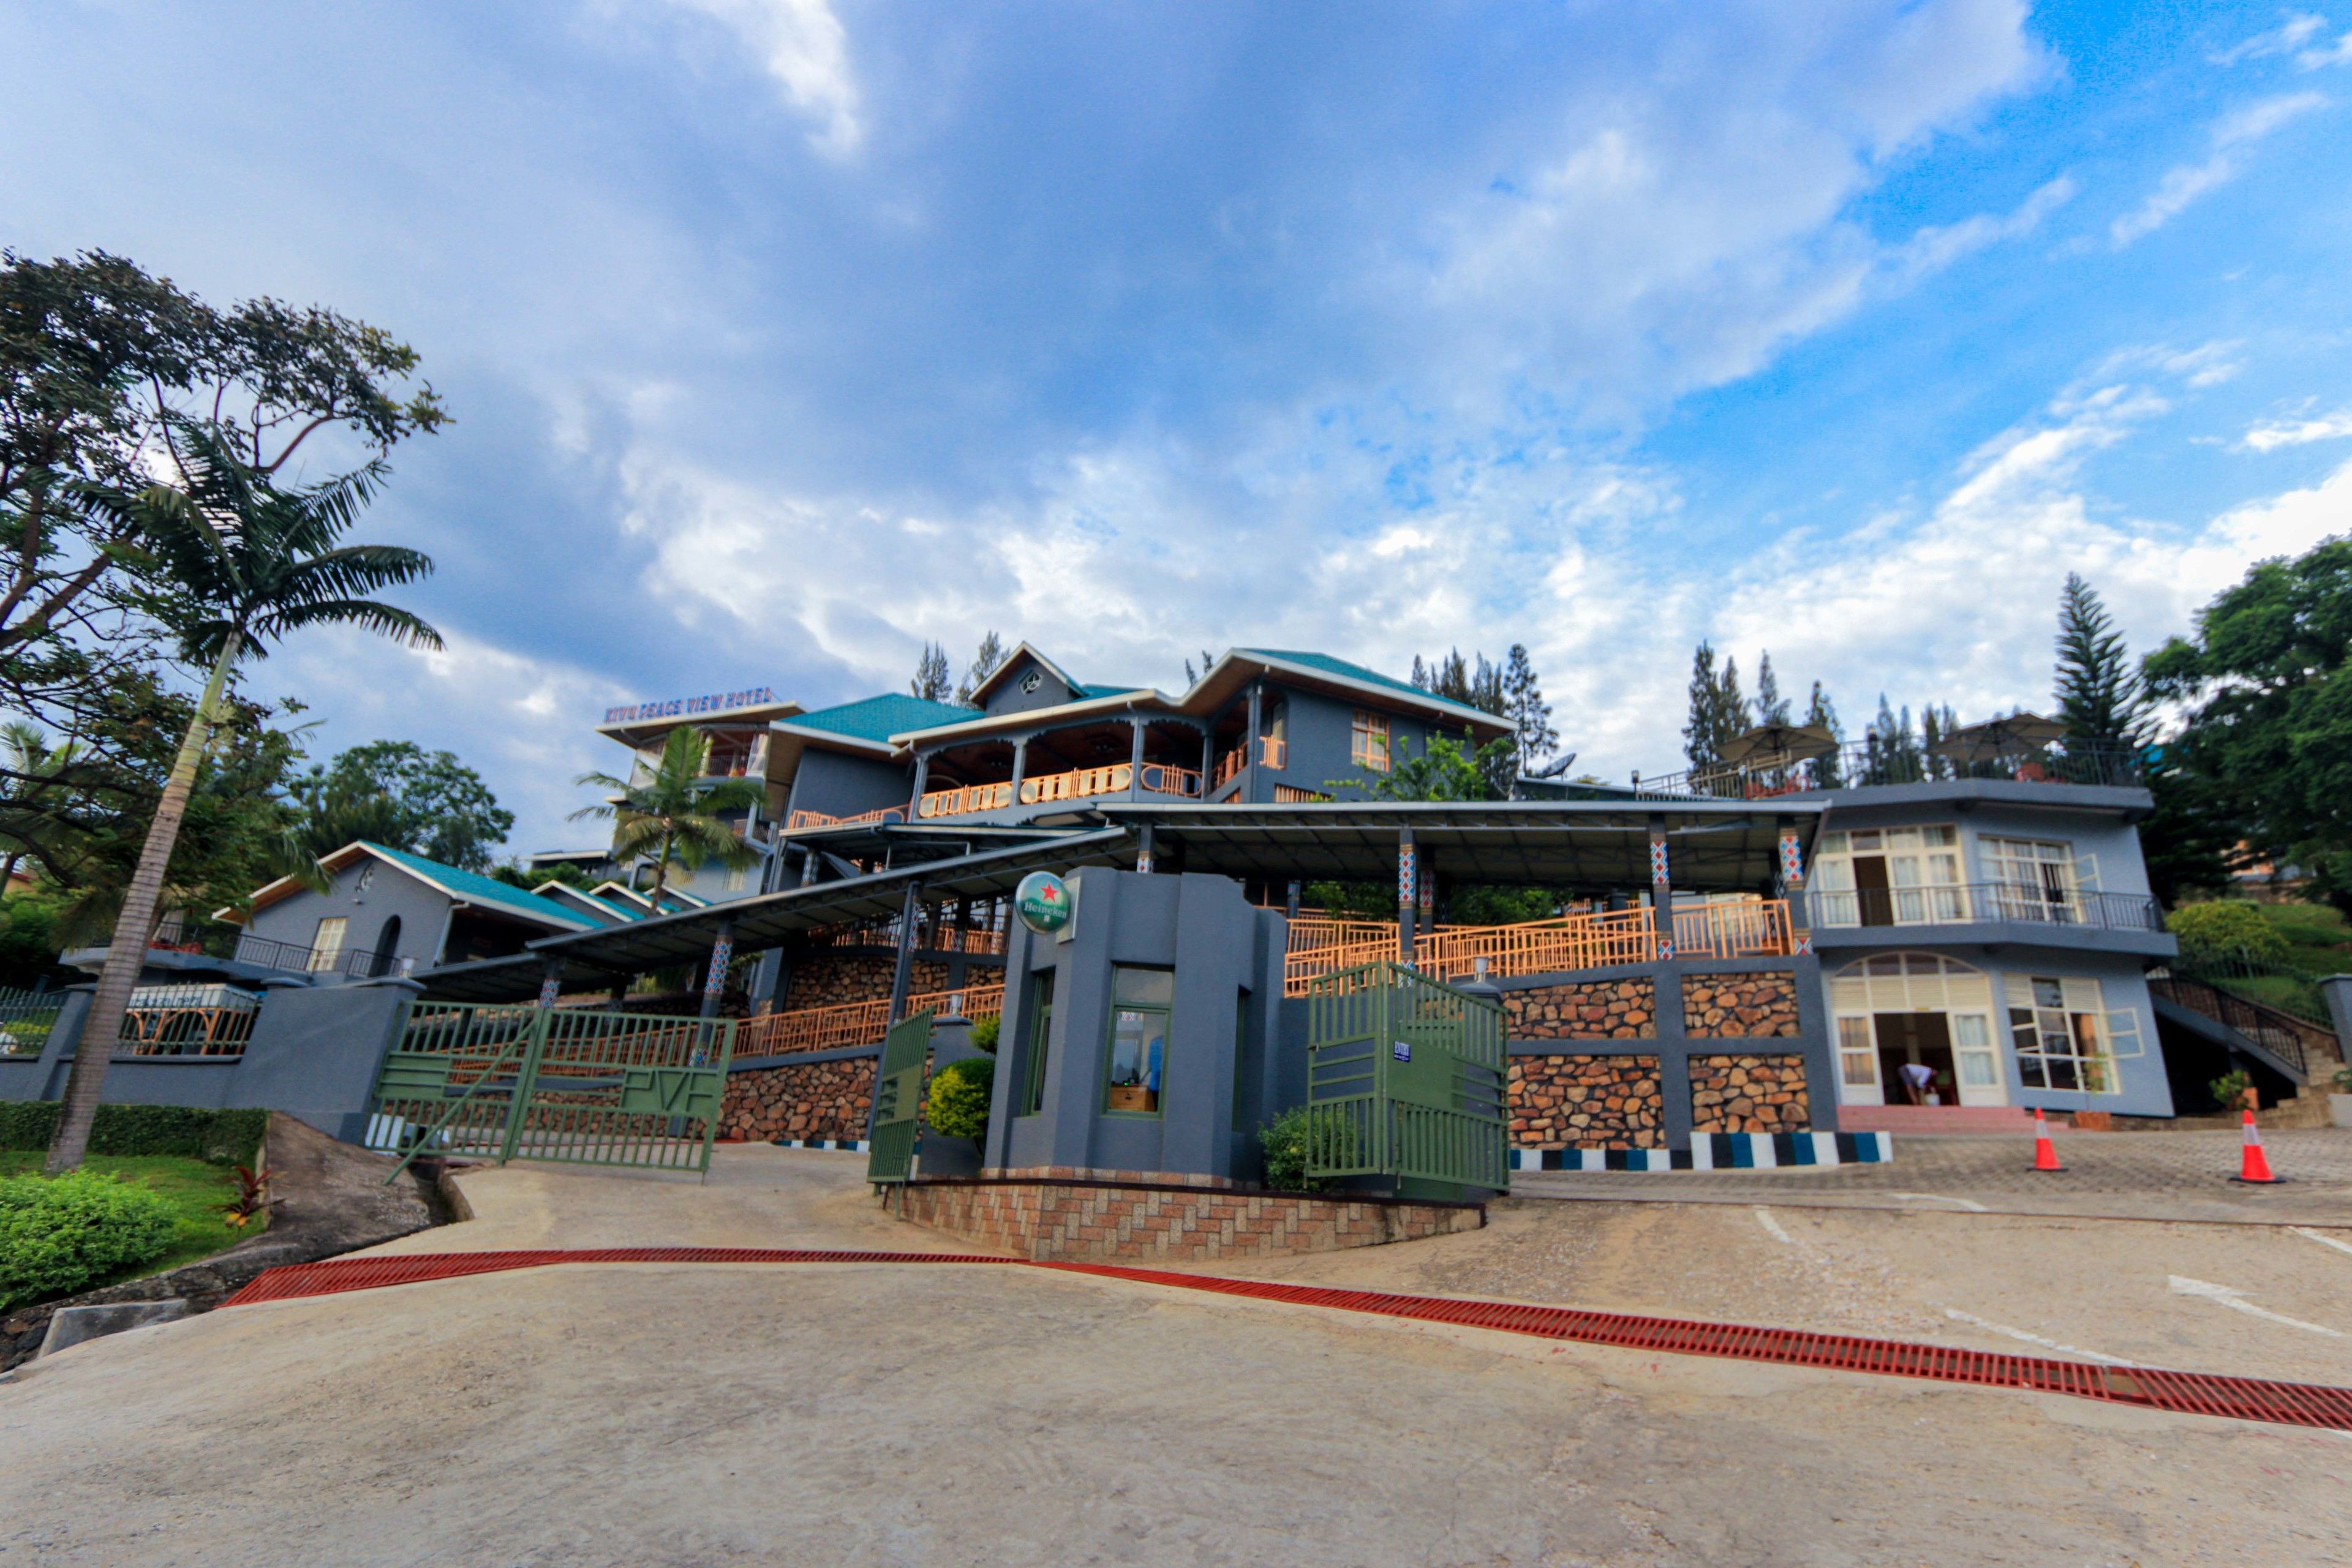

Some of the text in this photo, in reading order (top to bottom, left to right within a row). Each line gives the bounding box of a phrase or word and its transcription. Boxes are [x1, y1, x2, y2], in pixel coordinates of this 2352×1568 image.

[638, 699, 685, 720] PEACE
[687, 694, 725, 714] VIEW
[726, 686, 772, 708] HOTEL
[1024, 902, 1068, 919] Heineken
